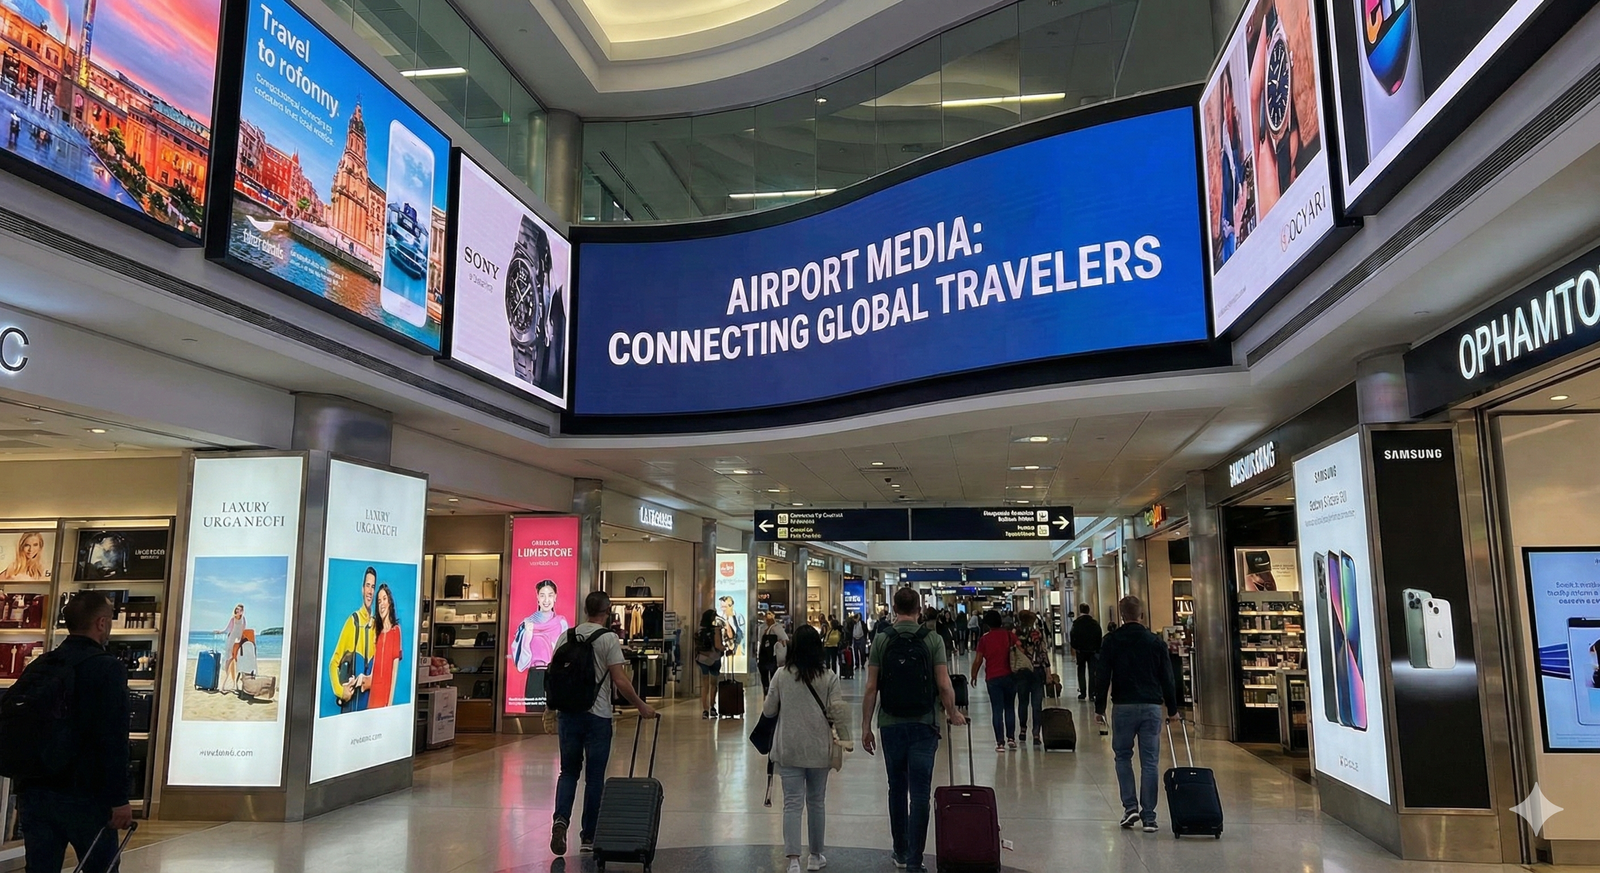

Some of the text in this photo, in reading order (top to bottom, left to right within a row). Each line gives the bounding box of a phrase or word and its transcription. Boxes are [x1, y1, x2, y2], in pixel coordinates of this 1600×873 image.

[257, 38, 276, 68] to
[260, 3, 311, 63] Travel
[464, 246, 500, 280] SONY
[726, 216, 983, 316] AIRPORT MEDIA:
[608, 313, 810, 366] CONNECTING
[817, 282, 930, 345] GLOBAL
[935, 234, 1163, 313] TRAVELERS
[1459, 264, 1600, 380] OPHAMTO
[1384, 449, 1443, 460] SAMSUNG
[221, 501, 270, 513] LAXURY
